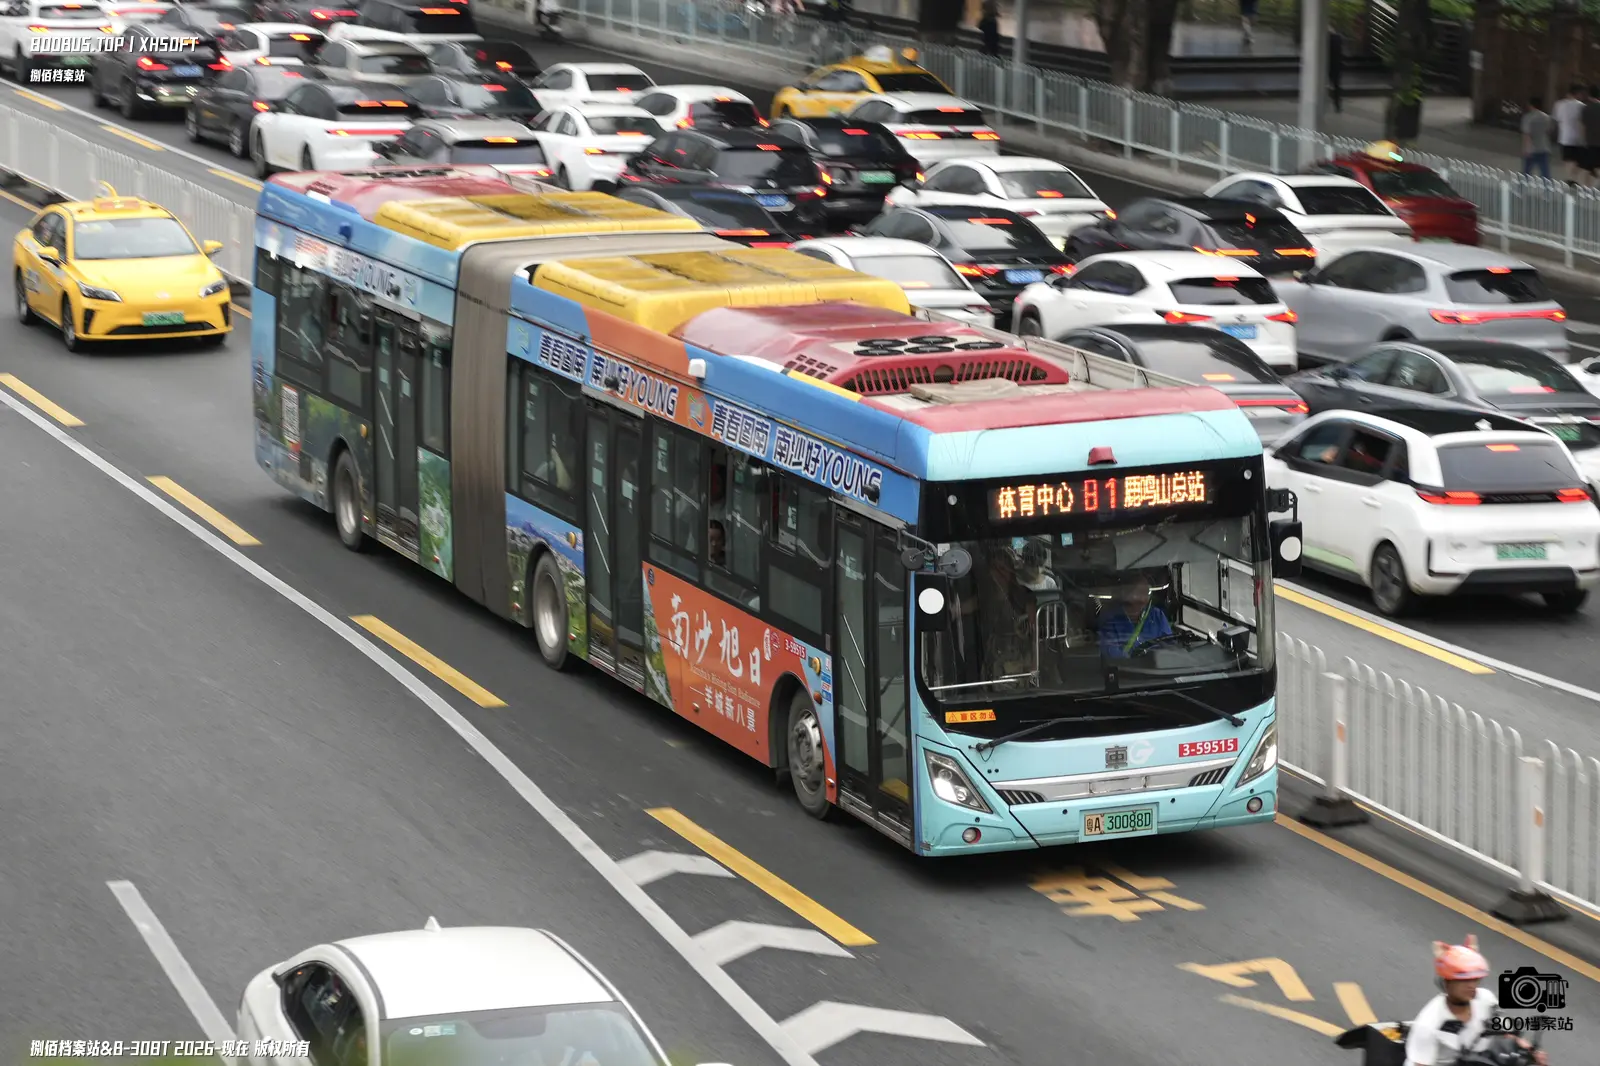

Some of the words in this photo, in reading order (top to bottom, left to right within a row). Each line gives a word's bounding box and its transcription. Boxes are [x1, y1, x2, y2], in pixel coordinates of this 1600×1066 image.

[712, 402, 770, 456] 青春图南
[998, 482, 1074, 519] 体育中心
[1124, 471, 1205, 508] 鹿鸣山总站
[668, 592, 761, 687] 南沙旭日
[784, 638, 806, 659] 3-59515
[1182, 740, 1235, 756] 3-59515
